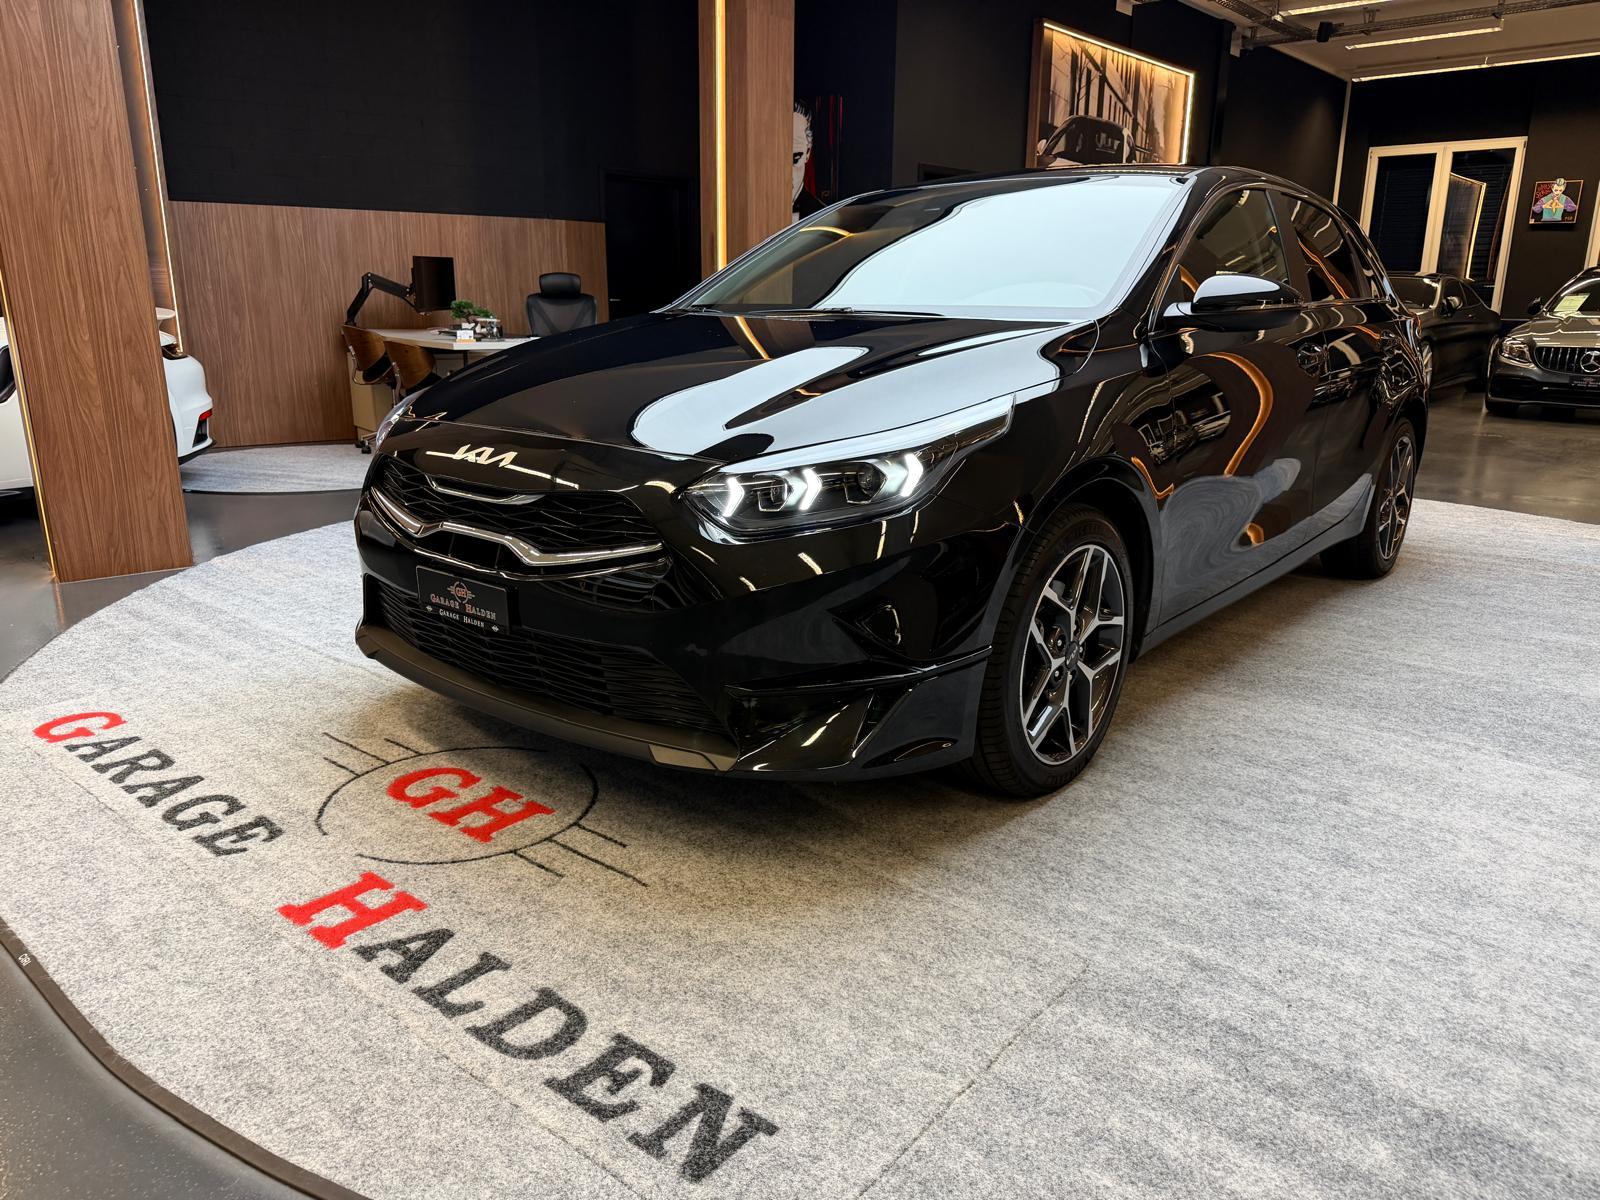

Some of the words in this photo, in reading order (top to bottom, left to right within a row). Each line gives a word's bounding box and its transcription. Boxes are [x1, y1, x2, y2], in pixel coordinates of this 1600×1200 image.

[453, 444, 517, 467] KIA
[430, 593, 460, 609] GARAGE
[464, 603, 497, 620] HALDEN
[439, 608, 460, 621] GARAGE
[463, 615, 485, 628] HALDEN
[386, 766, 555, 843] GH
[32, 711, 285, 856] GARAGE
[276, 871, 780, 1183] HALDEN
